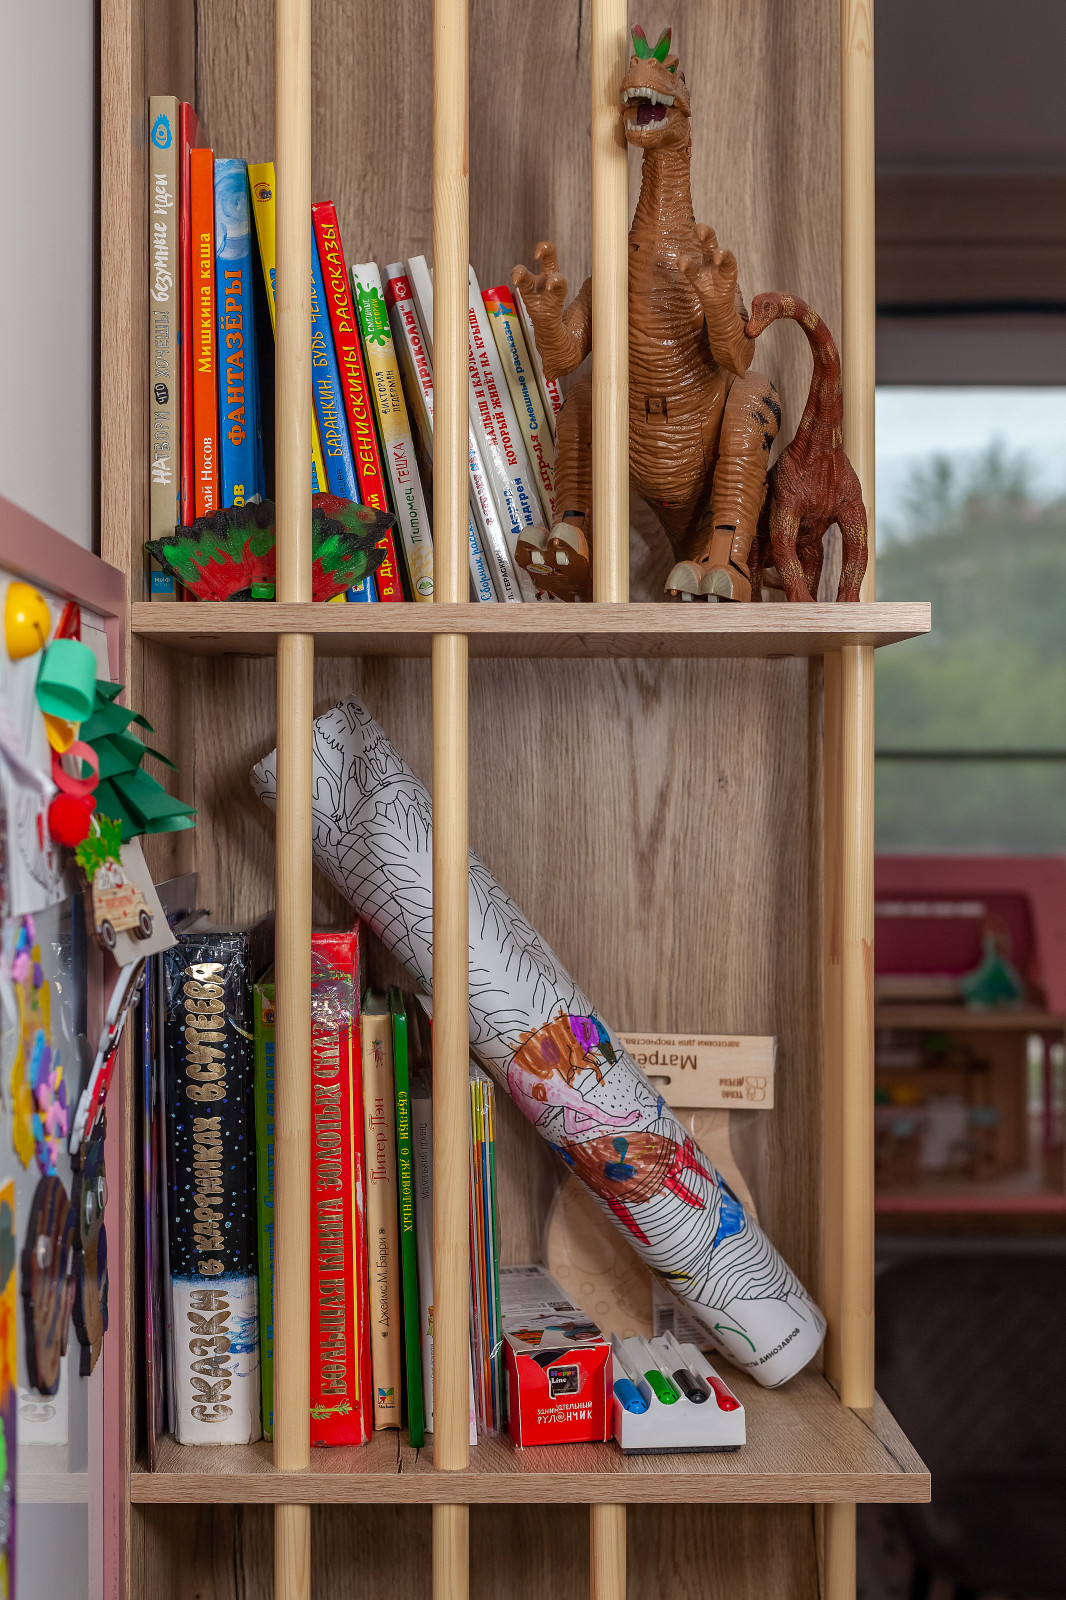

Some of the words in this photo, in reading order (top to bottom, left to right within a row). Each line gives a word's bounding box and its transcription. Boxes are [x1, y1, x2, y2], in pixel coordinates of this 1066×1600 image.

[153, 173, 174, 215] идеи
[199, 232, 211, 279] каша
[321, 223, 353, 333] РАССКАЗЫ
[197, 286, 212, 373] Мишкина
[362, 298, 375, 332] СМЕШНЫЕ
[371, 298, 383, 330] ИСТОРИИ
[469, 307, 486, 349] КРЫШЕ
[152, 310, 170, 379] ХОЧЕШЬ!
[221, 269, 246, 446] ФАНТАЗЁРЫ
[311, 331, 328, 368] БУДЬ
[478, 351, 490, 368] НА
[502, 320, 524, 374] рассказы
[154, 383, 168, 405] ЧТО
[342, 345, 377, 478] ДЕНИСКИНЫ
[375, 370, 391, 415] ВИКТОРИЯ
[386, 369, 401, 413] ЛЕДЕРМАН
[473, 390, 485, 399] И
[482, 370, 502, 409] ЖИВЁТ
[517, 375, 538, 430] Смешные
[317, 374, 343, 457] БАРАНКИН,
[477, 400, 499, 447] МАЛЫШ
[496, 410, 518, 466] КОТОРЫЙ
[151, 411, 172, 486] НАТВОРИ
[200, 437, 212, 481] Носов
[393, 442, 411, 485] ГЕШКА
[531, 434, 553, 492] апреля
[403, 488, 422, 544] Питомец
[383, 583, 394, 596] В.
[475, 556, 492, 601] Сборник
[678, 1038, 696, 1048] для
[697, 1039, 741, 1049] заготовки
[369, 1097, 389, 1130] Пэн
[397, 1091, 410, 1140] СКАЗКИ
[419, 1122, 429, 1151] принц
[313, 1082, 343, 1192] ЗОЛОТЫХ
[370, 1132, 390, 1185] Питер
[192, 1116, 225, 1251] КАРТИНКАХ
[399, 1159, 413, 1233] ЖИВОТНЫХ
[419, 1151, 430, 1200] Маленький
[316, 1196, 345, 1273] КНИГА
[376, 1237, 390, 1269] Барри
[376, 1270, 389, 1284] М.
[377, 1285, 391, 1327] Джеймс
[187, 1289, 233, 1424] СКАЗКИ
[318, 1277, 348, 1397] БОЛЬШАЯ
[759, 1327, 801, 1365] ДИНОЗАВРОВ
